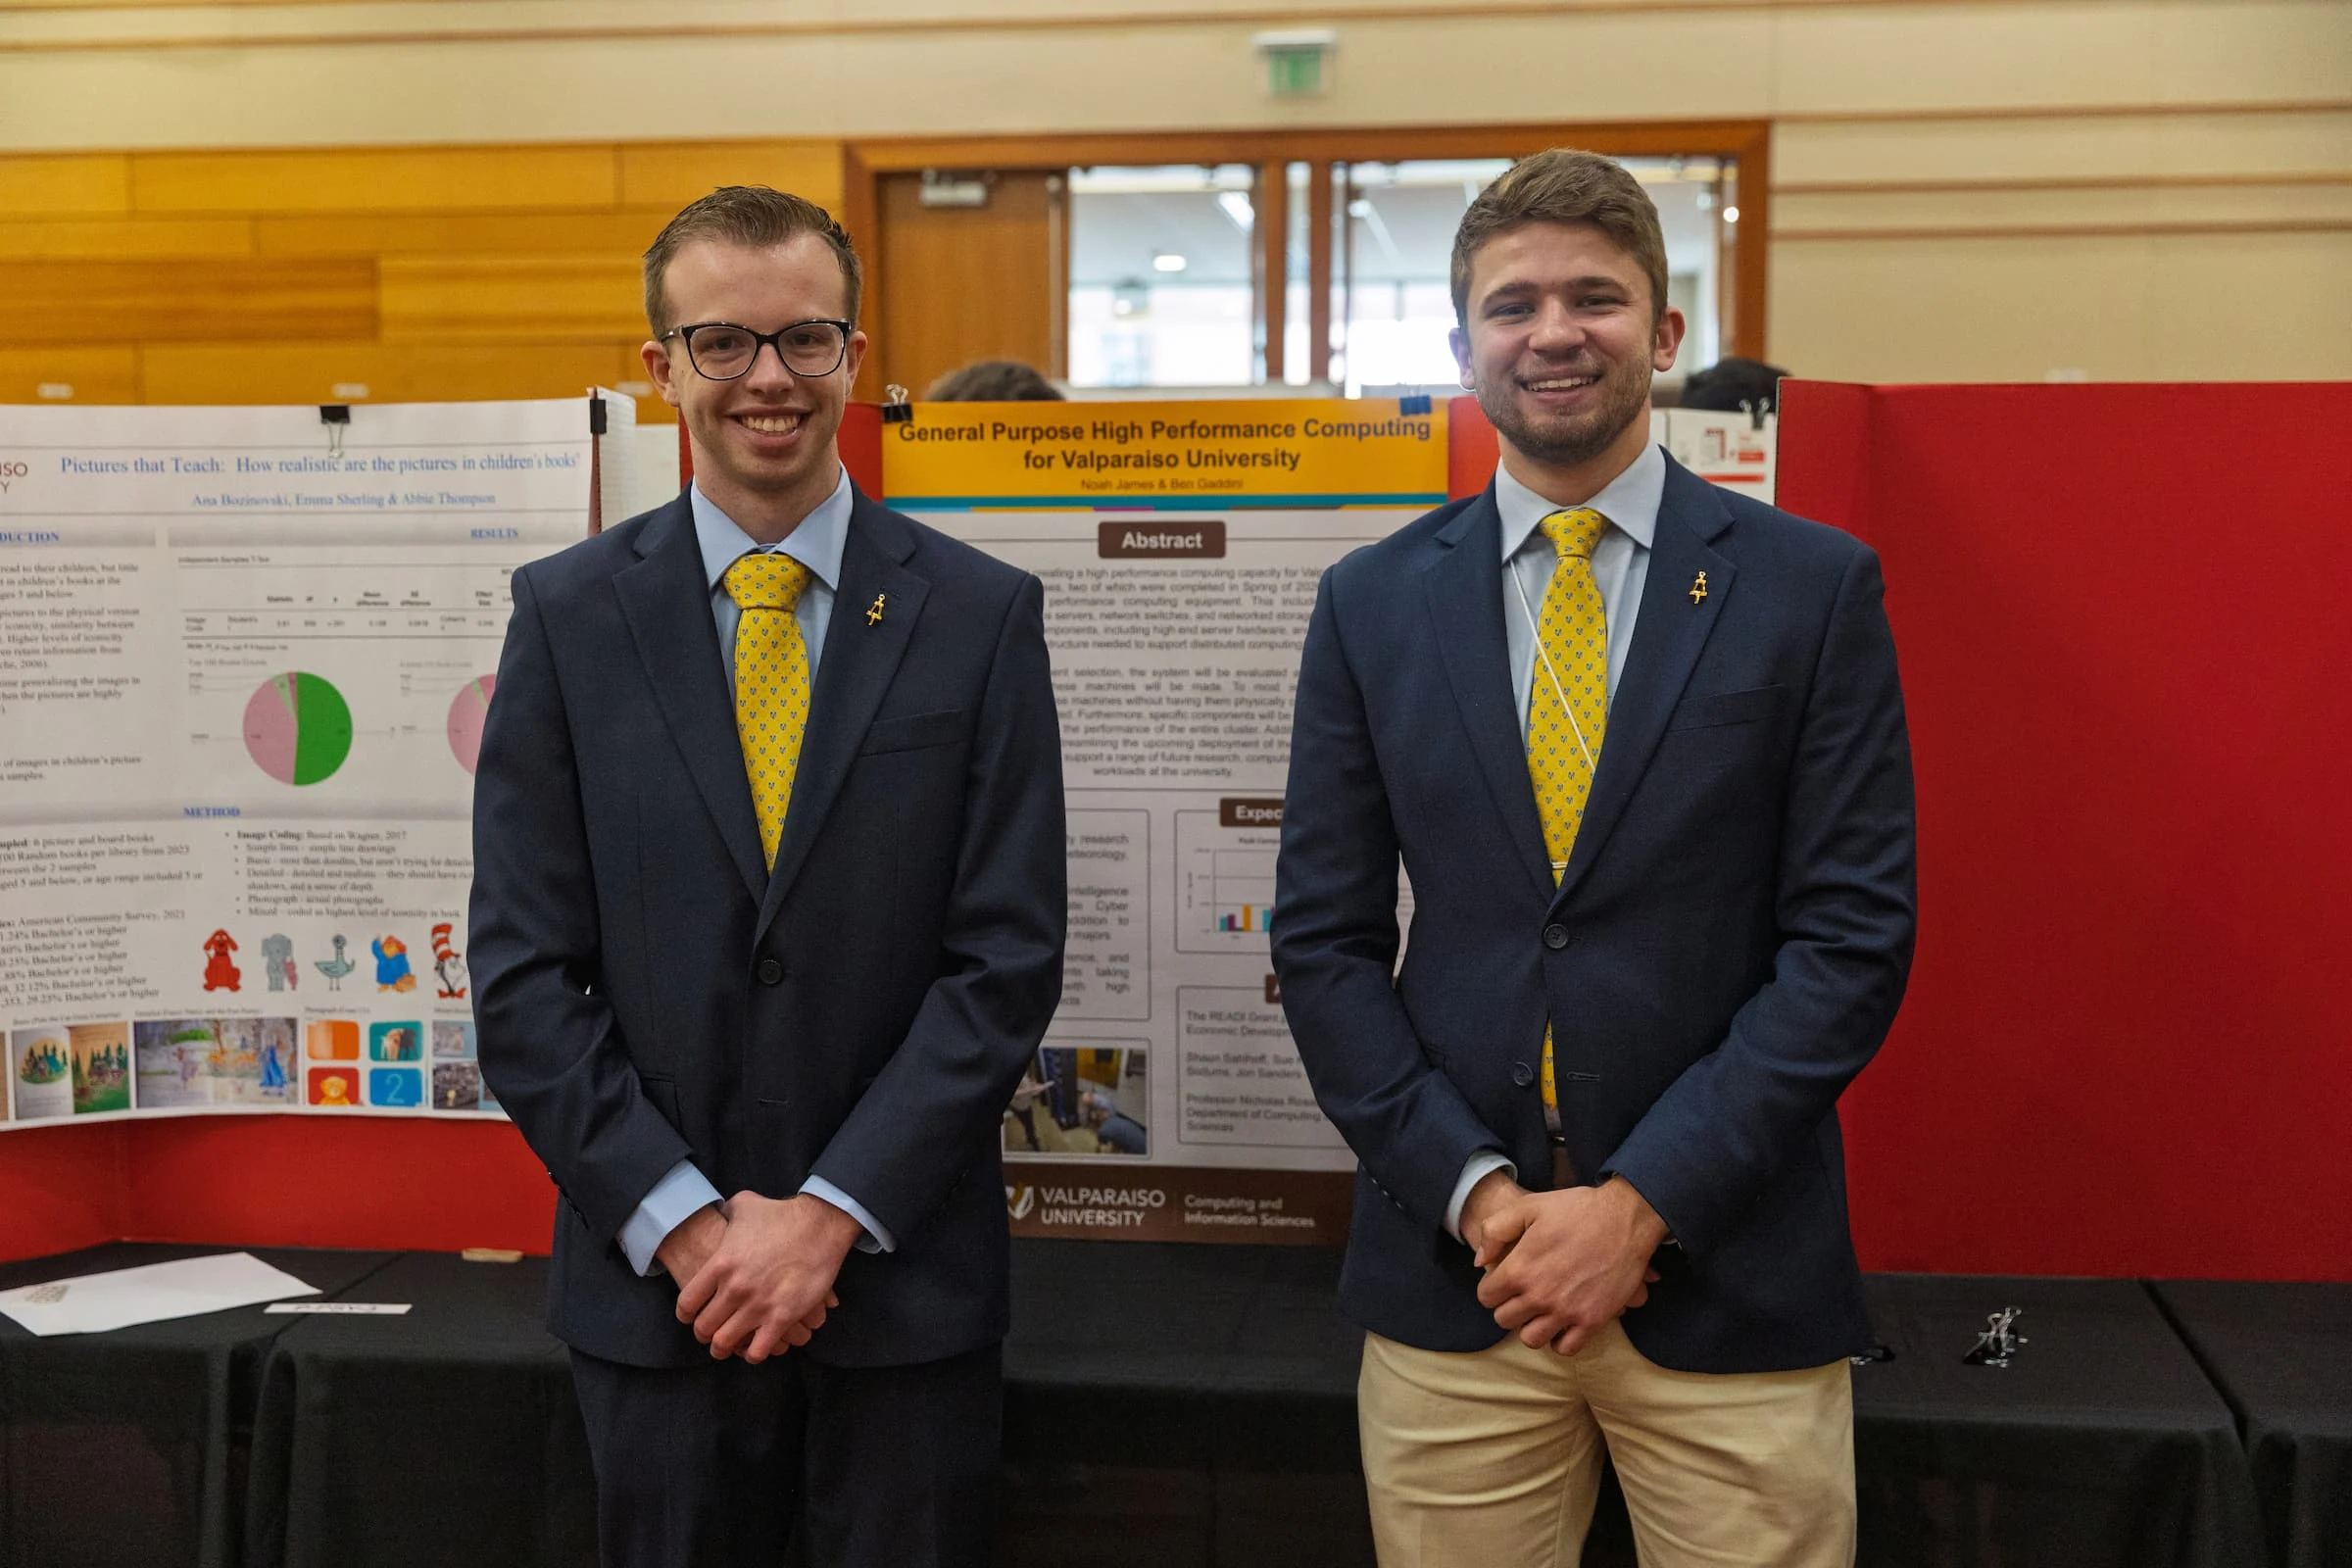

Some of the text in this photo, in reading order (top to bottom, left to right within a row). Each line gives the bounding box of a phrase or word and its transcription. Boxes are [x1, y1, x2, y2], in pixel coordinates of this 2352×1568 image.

[899, 418, 1431, 446] General Purpose High Performance Computing
[61, 457, 128, 473] Pictures
[134, 457, 166, 472] that
[171, 457, 224, 472] Teach:
[236, 457, 272, 472] How
[278, 456, 339, 472] realistic
[344, 459, 367, 472] are
[372, 456, 394, 471] the
[399, 456, 457, 474] pictures
[463, 456, 475, 470] in
[480, 454, 542, 470] children's
[1024, 448, 1300, 472] for Valparaiso University
[1081, 478, 1244, 491] Noah James & Ben Gaddini
[193, 493, 496, 509] Ana Bozinovski, Emma Sherling & Abbie Thompson
[470, 528, 518, 540] RESULTS
[1122, 531, 1203, 549] Abstract
[1050, 597, 1115, 609] performance
[1123, 597, 1177, 609] computing
[1252, 596, 1273, 607] This
[1092, 639, 1131, 650] needed
[1134, 640, 1145, 650] to
[1148, 640, 1188, 652] support
[1191, 639, 1245, 650] distributed
[1071, 696, 1285, 709] machines without having them physically
[1094, 766, 1146, 777] workloads
[1161, 766, 1178, 776] the
[183, 807, 240, 818] METHOD
[386, 1073, 405, 1102] 2
[1041, 1186, 1166, 1208] VALPARAISO
[1185, 1195, 1284, 1212] Computing and
[1041, 1209, 1145, 1228] UNIVERSITY
[1184, 1211, 1315, 1228] Information Sciences
